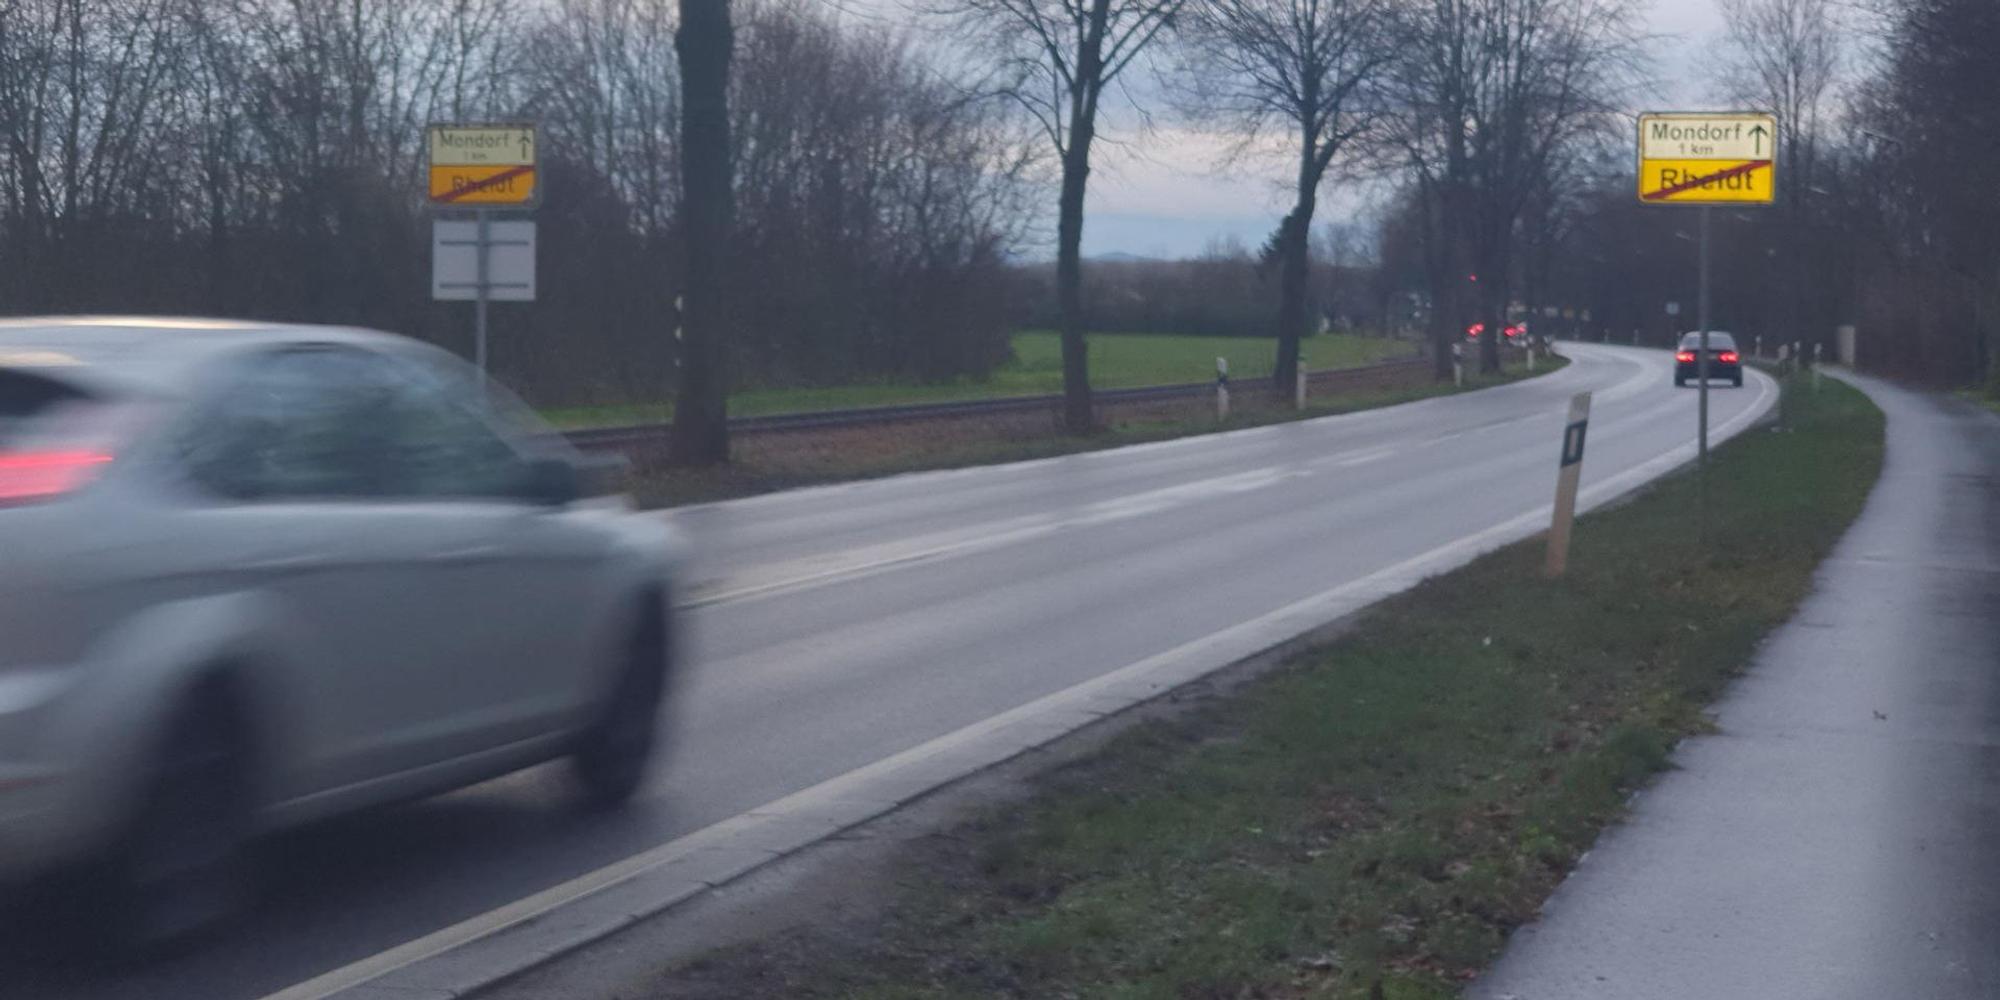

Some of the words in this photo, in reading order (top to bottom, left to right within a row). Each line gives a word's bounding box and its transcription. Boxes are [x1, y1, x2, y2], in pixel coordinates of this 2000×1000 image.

[438, 131, 509, 148] Mondorf
[1652, 123, 1741, 141] Mondorf
[471, 151, 488, 160] km
[1679, 144, 1685, 154] 1
[1690, 144, 1714, 155] km
[1661, 168, 1753, 191] Rheidt
